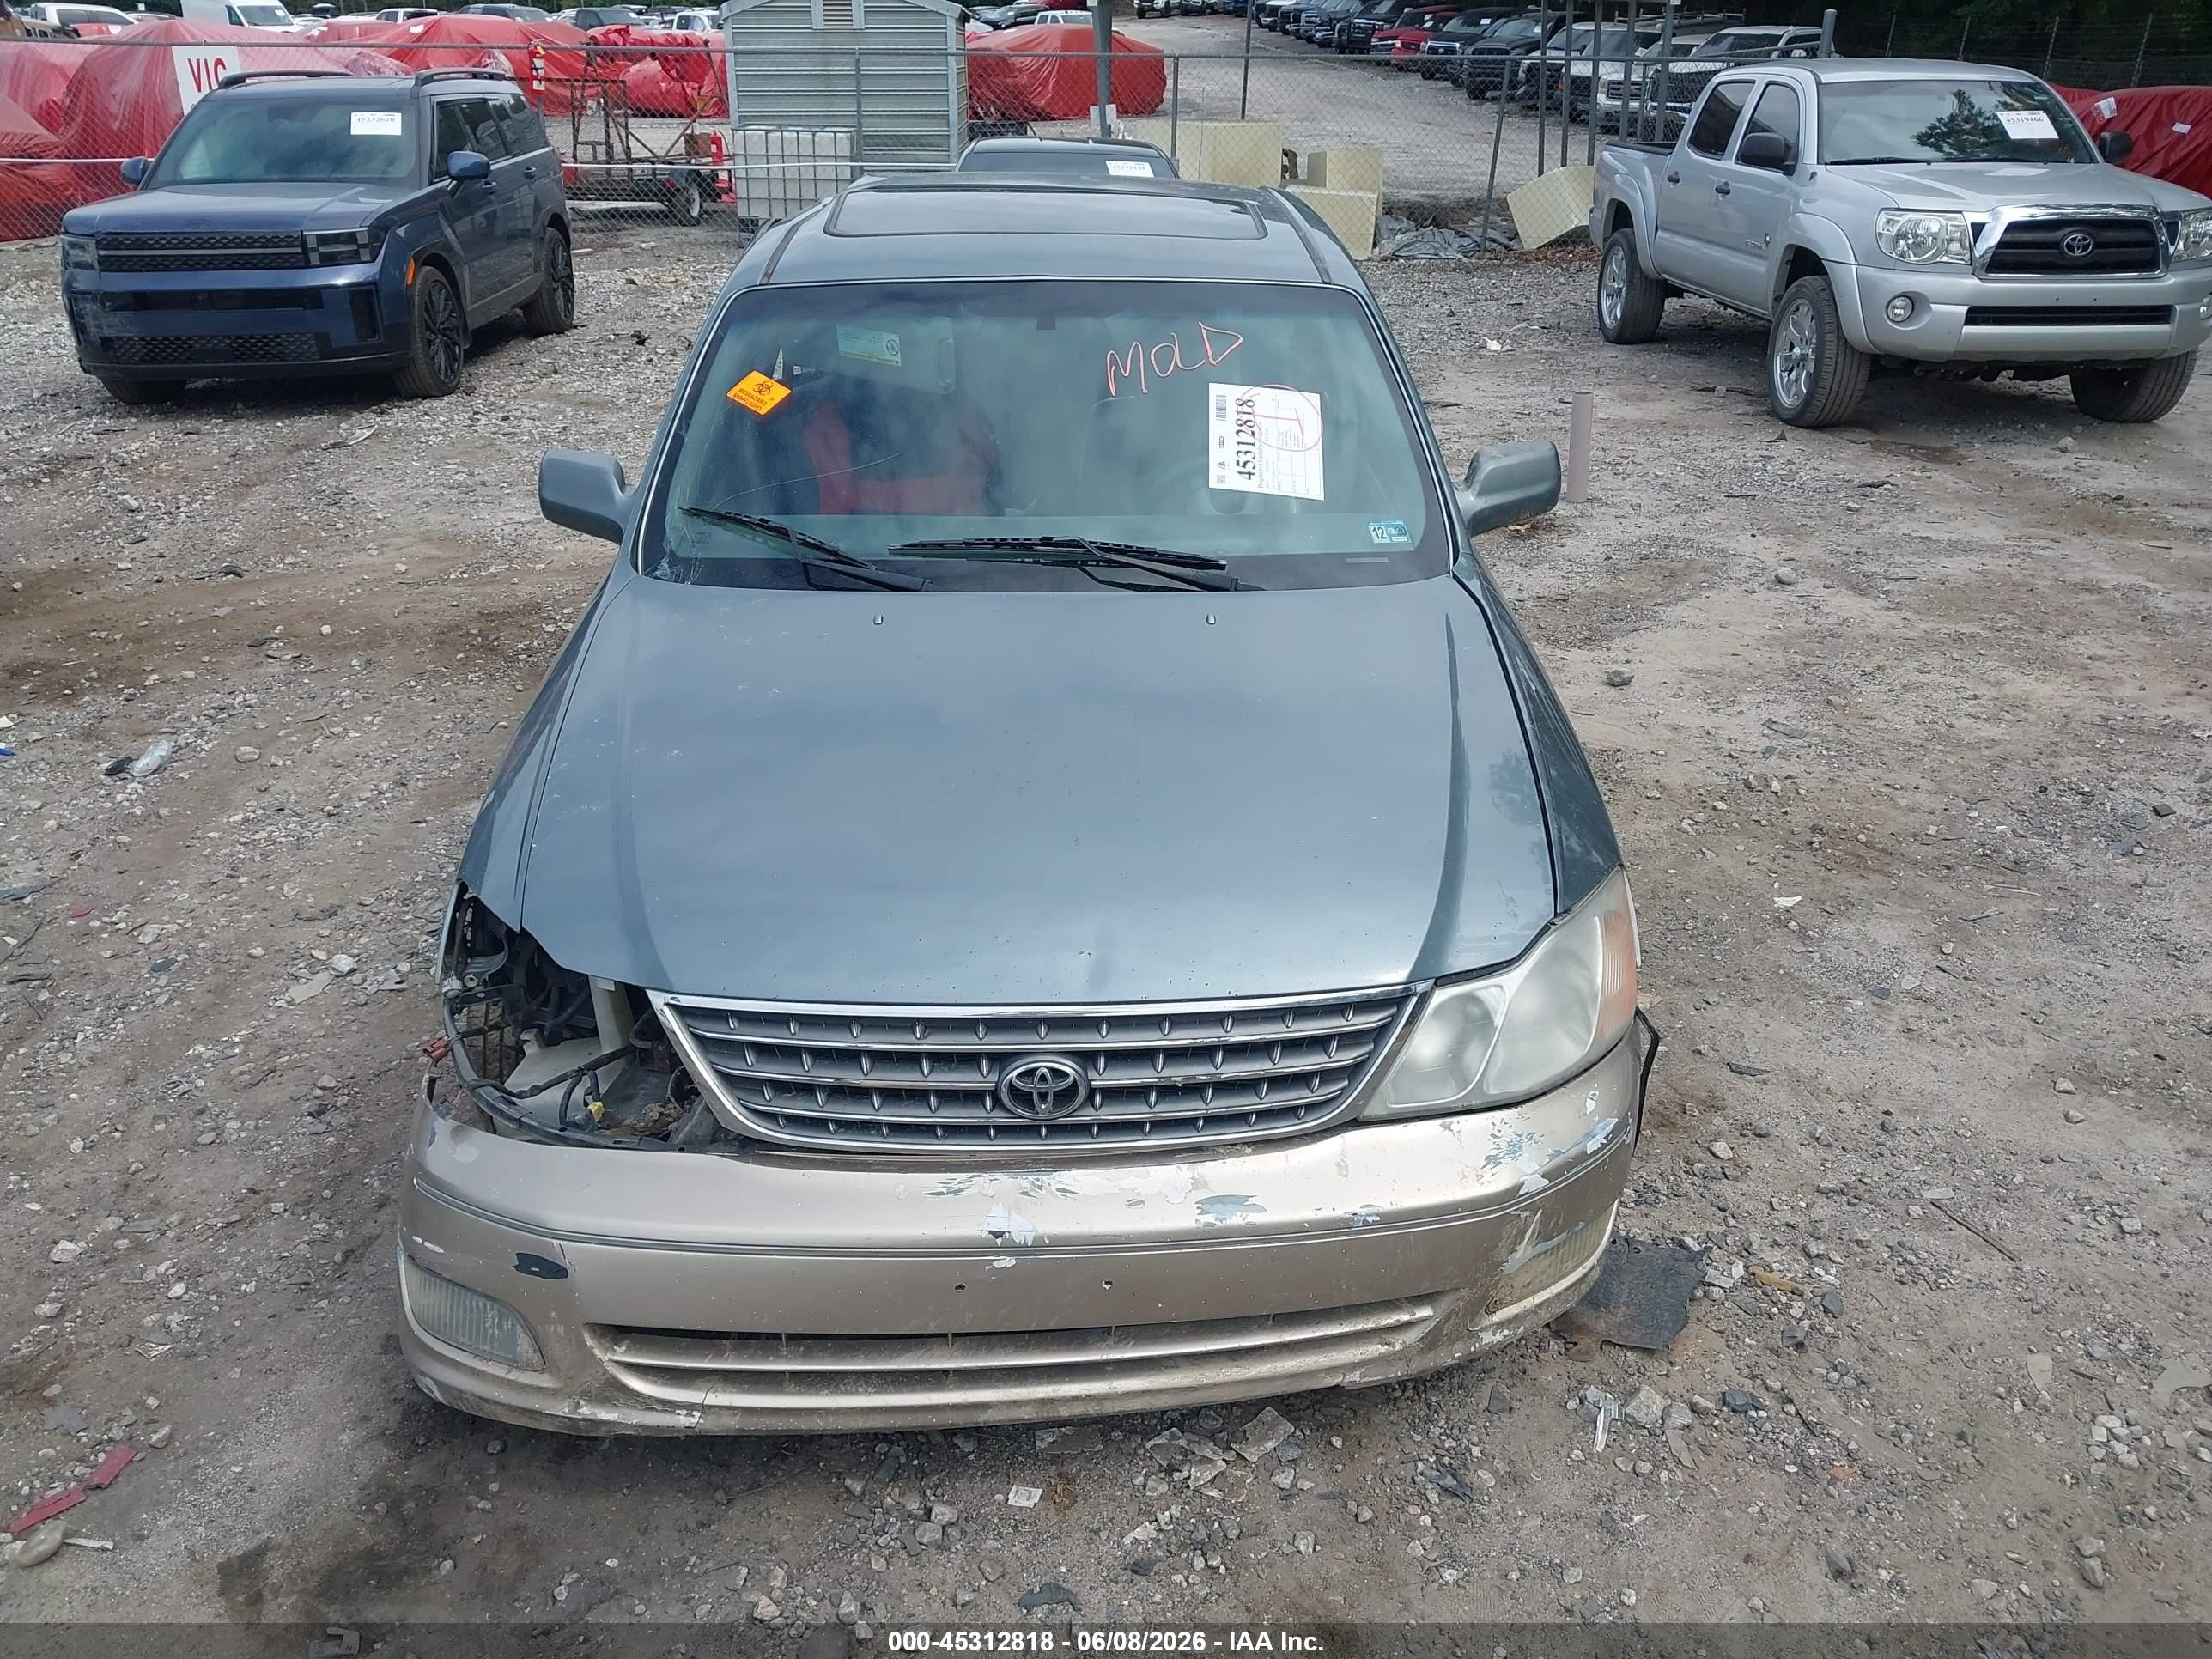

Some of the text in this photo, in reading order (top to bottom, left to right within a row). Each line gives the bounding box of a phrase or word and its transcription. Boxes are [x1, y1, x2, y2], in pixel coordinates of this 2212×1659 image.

[1106, 321, 1244, 397] MOLD
[1235, 398, 1256, 481] 45312818
[1372, 526, 1388, 539] 12
